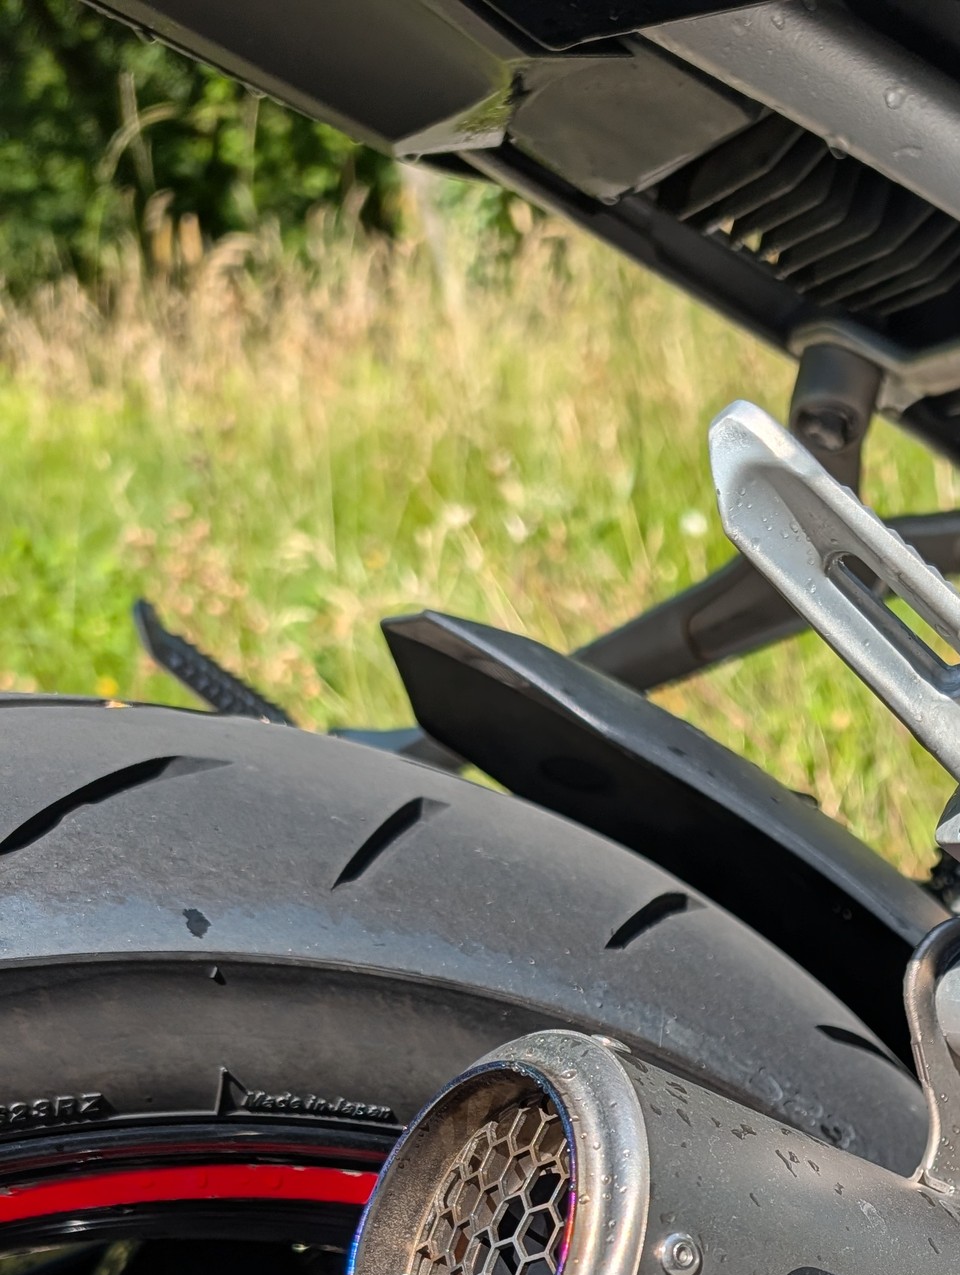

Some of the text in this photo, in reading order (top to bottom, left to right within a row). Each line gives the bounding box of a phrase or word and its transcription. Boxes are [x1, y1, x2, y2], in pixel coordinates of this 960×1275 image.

[241, 1090, 392, 1119] Made in Japan
